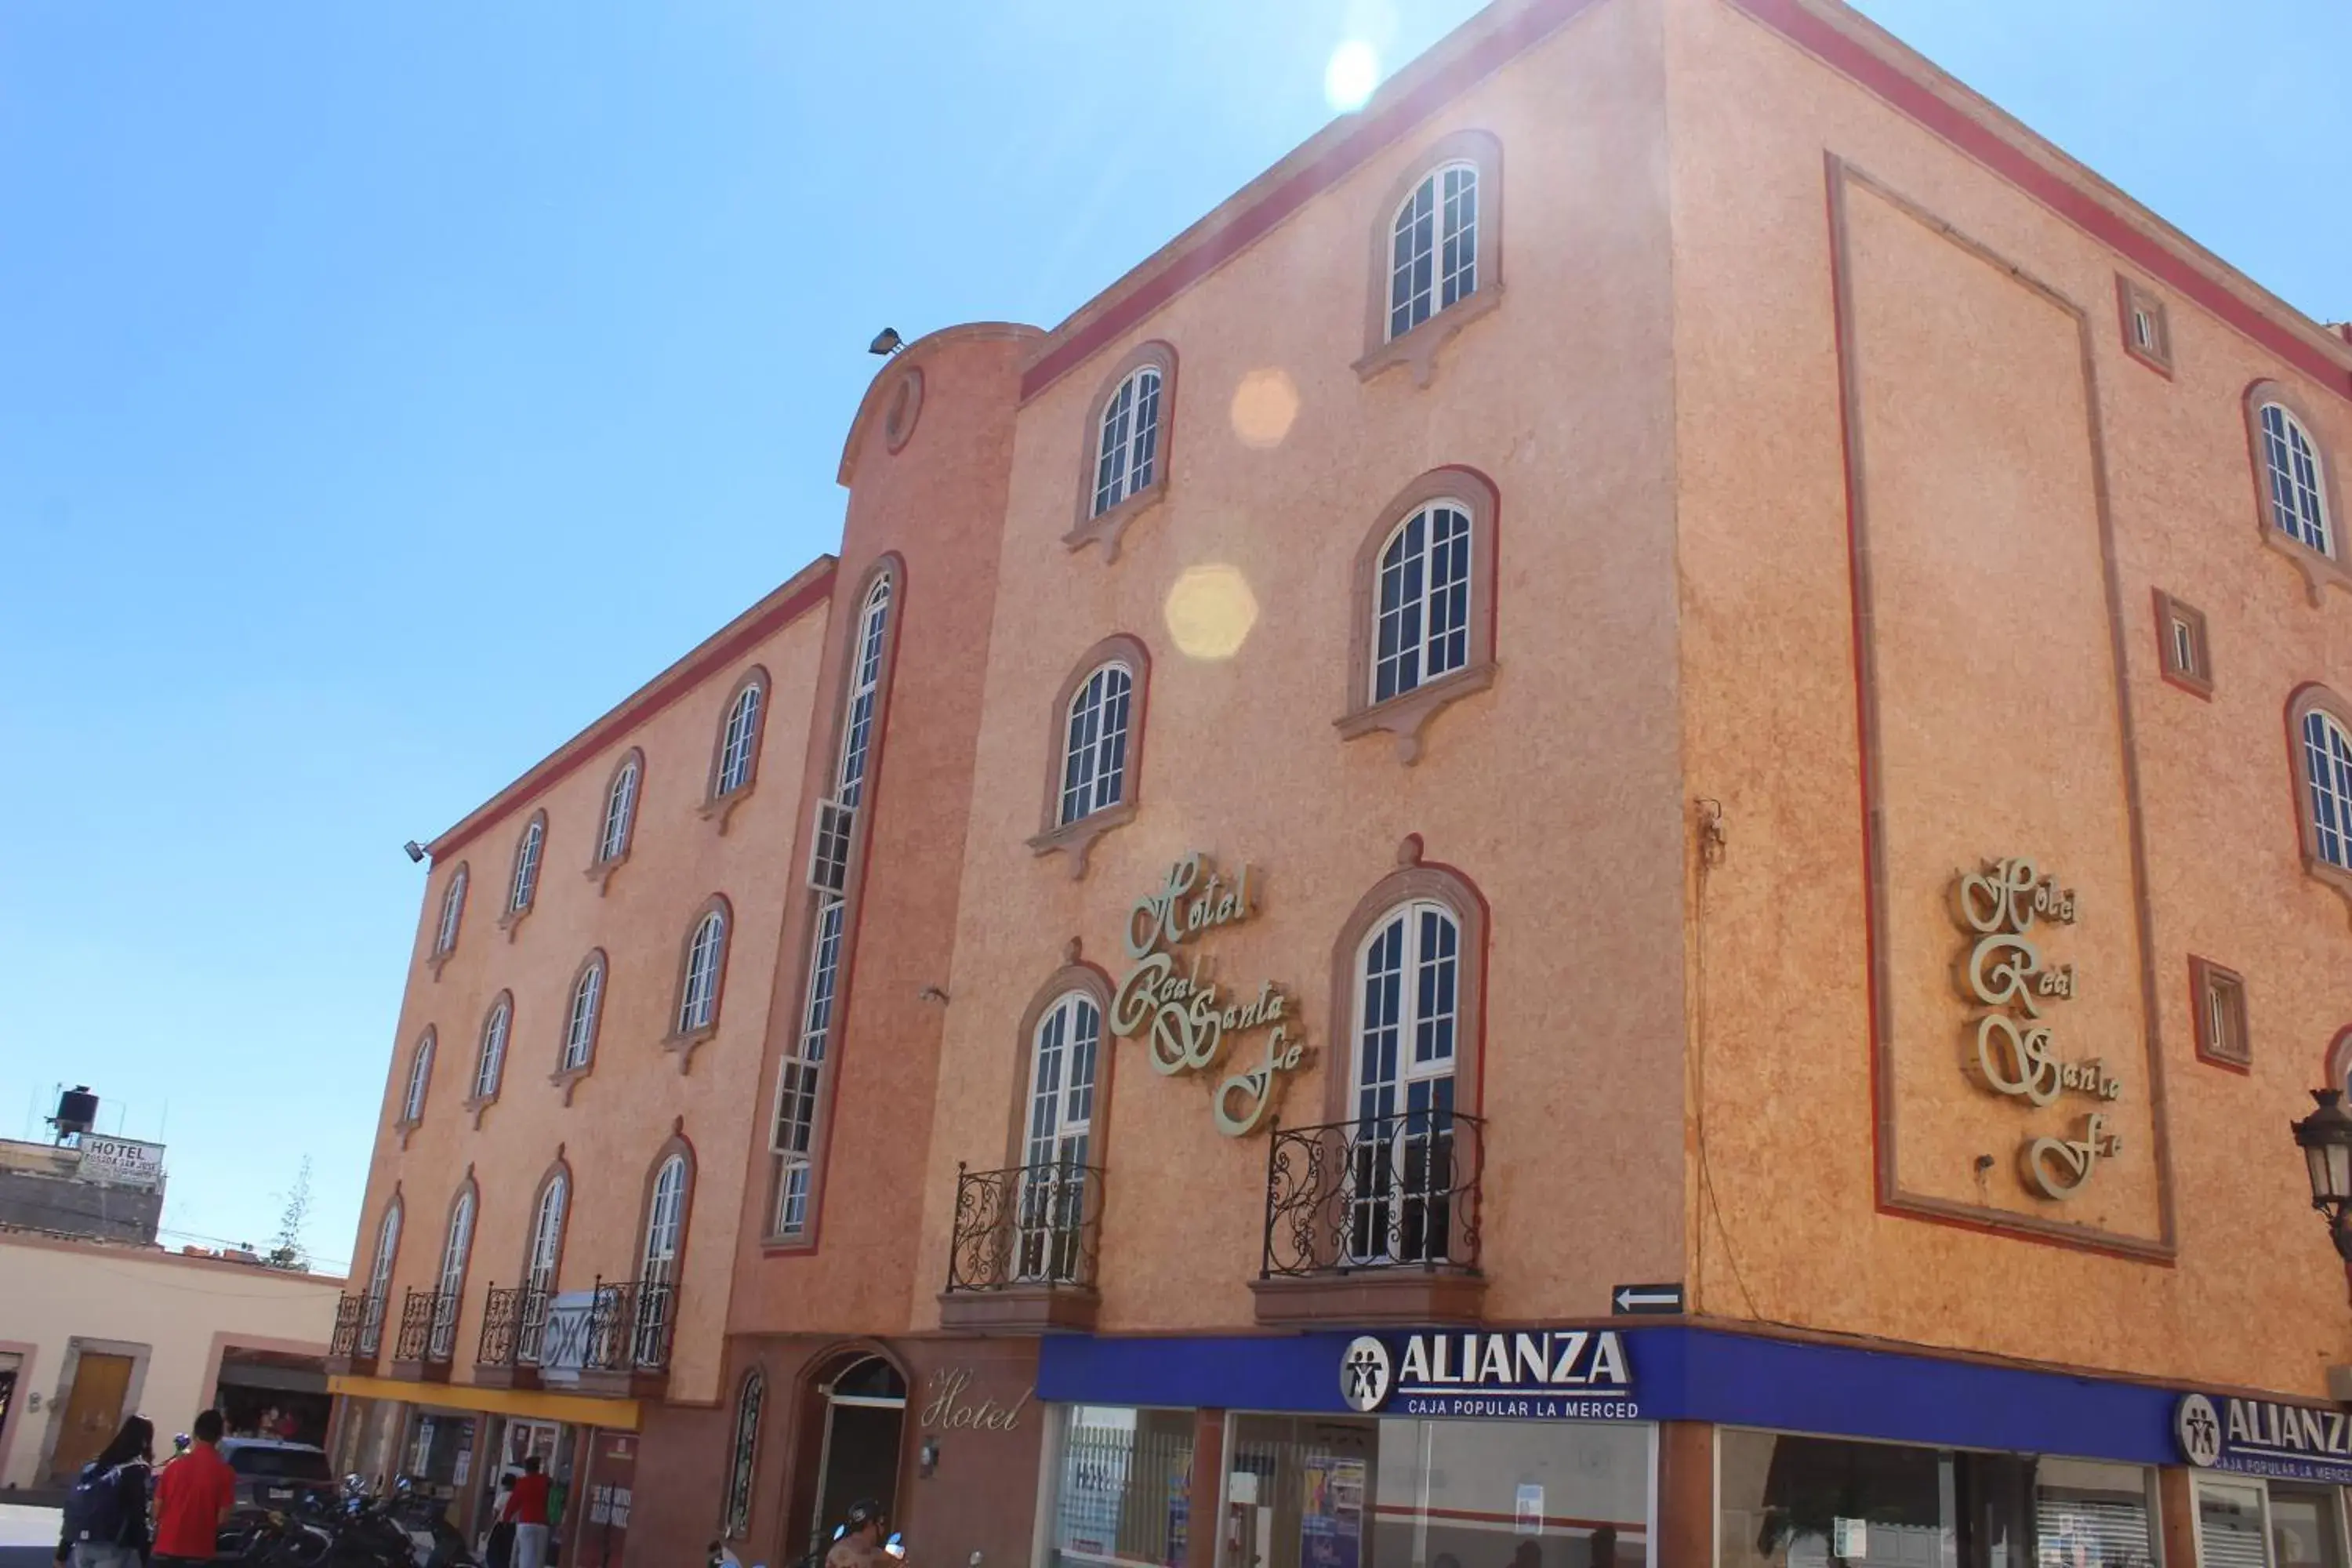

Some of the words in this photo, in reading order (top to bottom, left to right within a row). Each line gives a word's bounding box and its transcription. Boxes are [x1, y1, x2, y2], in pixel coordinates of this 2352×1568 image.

[1124, 851, 1251, 959] Hotel
[1960, 857, 2079, 933] Hotel
[1110, 953, 1200, 1036] Real
[1969, 935, 2078, 1018] Real
[1149, 982, 1287, 1076] Santa
[1978, 1014, 2122, 1107] Santa
[1214, 1025, 1302, 1138] Fe
[90, 1141, 144, 1160] HOTEL
[1398, 1331, 1628, 1385] ALIANZA
[921, 1367, 1036, 1431] Hotel
[1408, 1399, 1446, 1414] CAJA
[1454, 1400, 1528, 1417] POPULAR
[1537, 1402, 1557, 1417] LA
[1565, 1402, 1639, 1418] MERCED
[2228, 1398, 2352, 1456] ALIANZ
[2214, 1456, 2243, 1472] CAJA
[2246, 1459, 2296, 1476] POPULAR
[2299, 1464, 2313, 1477] LA
[2315, 1467, 2352, 1482] MERCE
